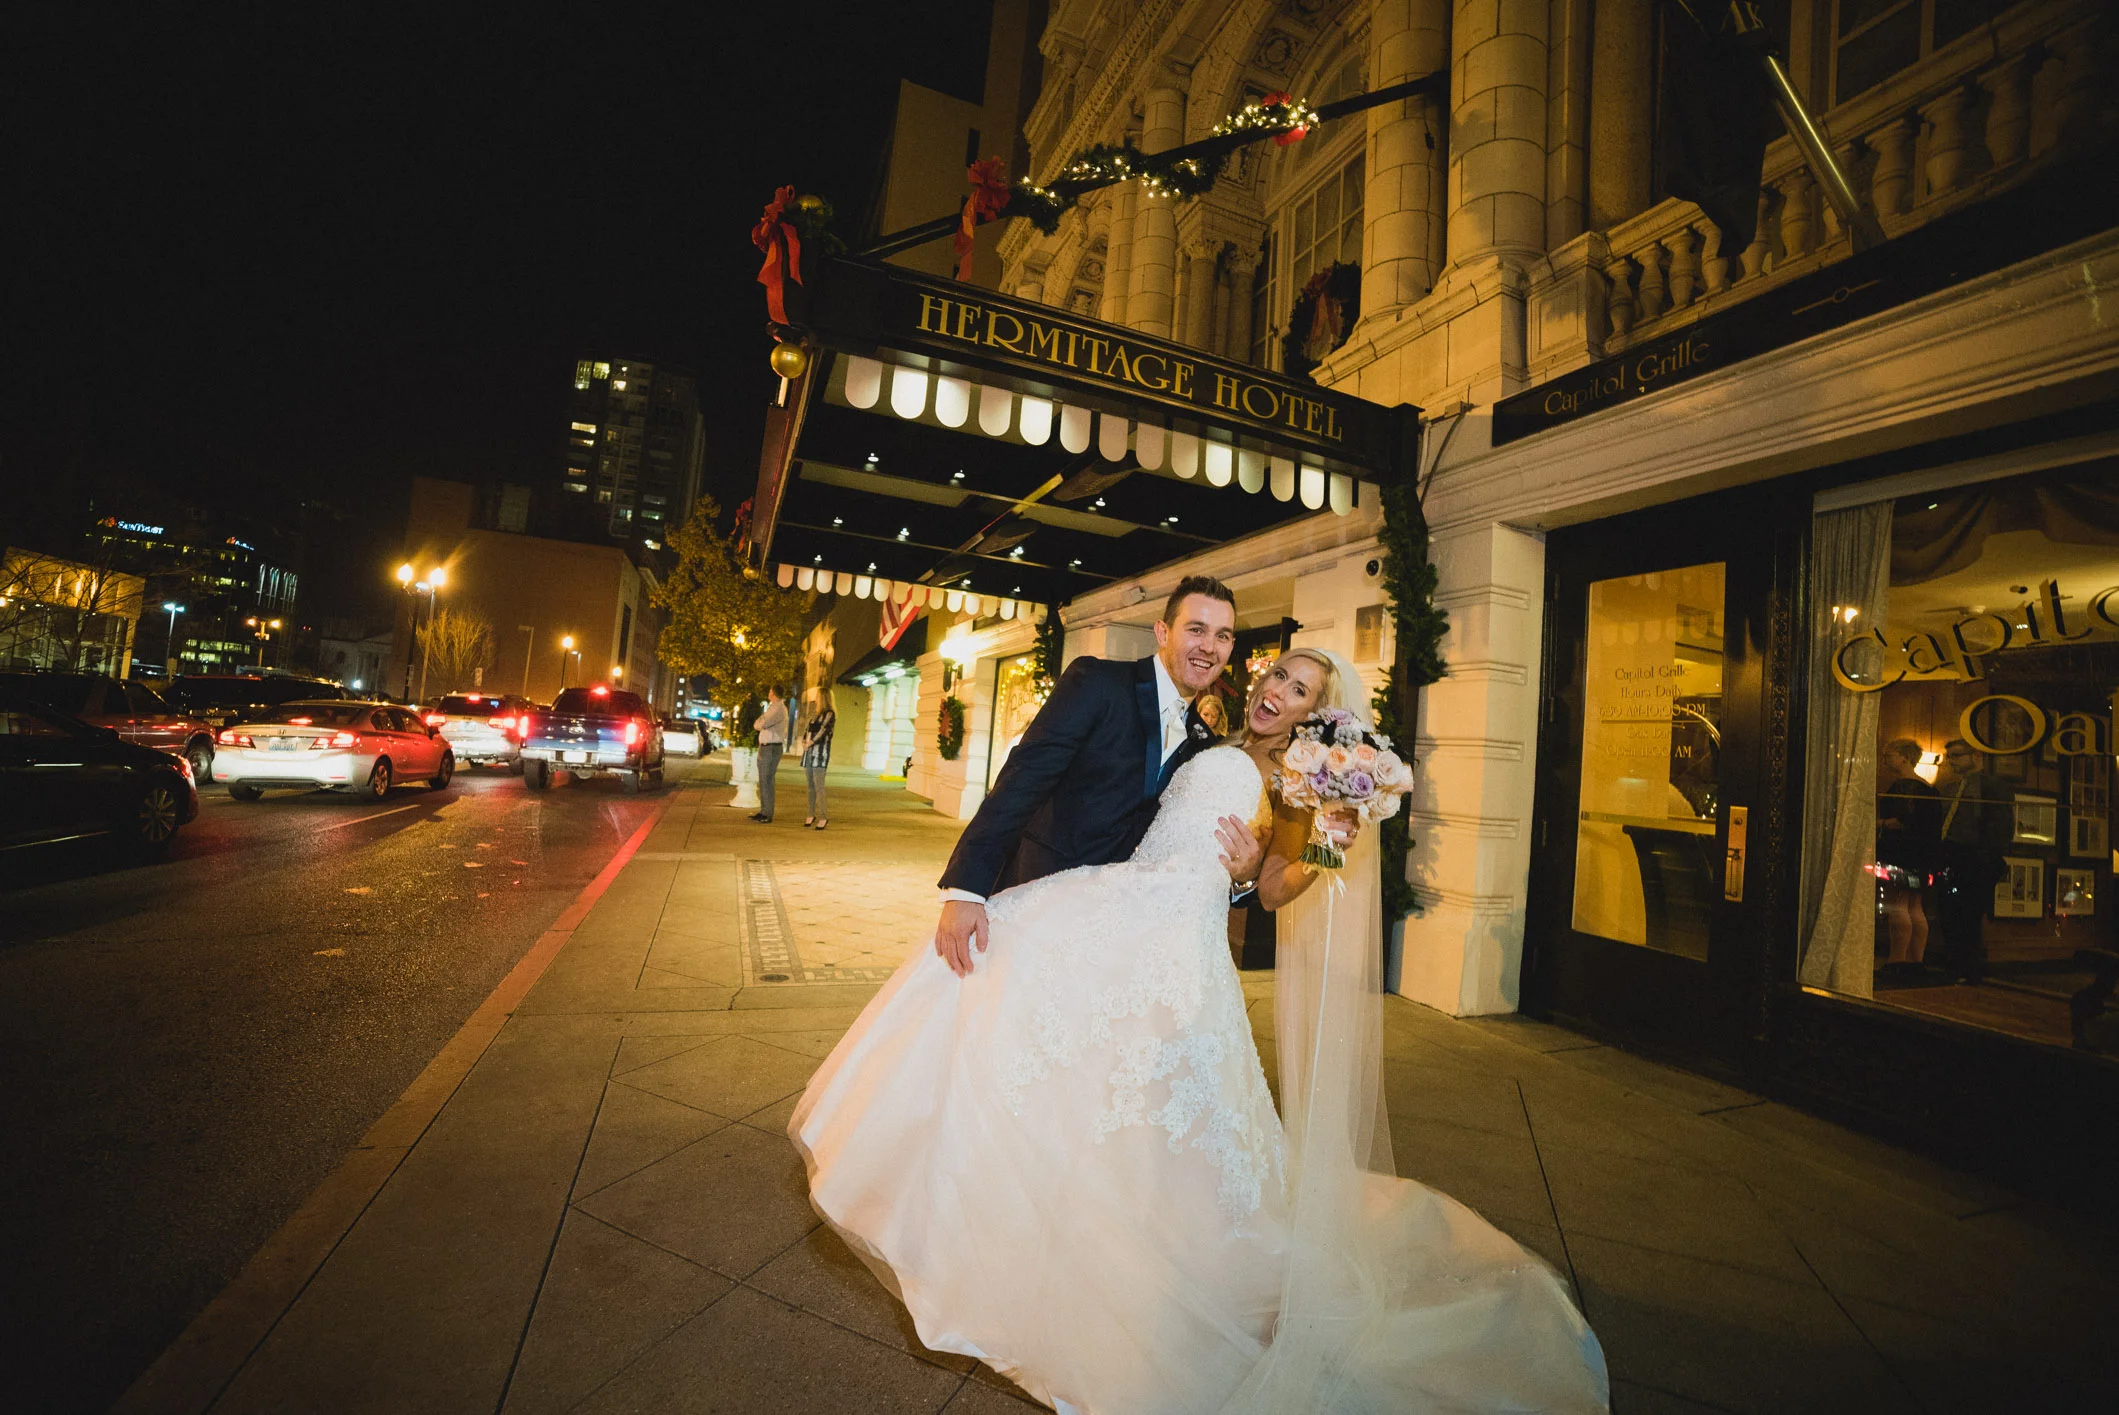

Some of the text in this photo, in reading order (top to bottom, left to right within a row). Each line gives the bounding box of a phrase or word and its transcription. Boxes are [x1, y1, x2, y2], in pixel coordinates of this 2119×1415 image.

[916, 293, 1342, 442] HERMITAGE HOTEL
[1544, 339, 1711, 416] Capitol Grille
[1614, 664, 1691, 683] Capitol Grille
[1621, 684, 1682, 701] Hours Daily
[1686, 703, 1706, 717] PM
[1674, 745, 1692, 758] AM
